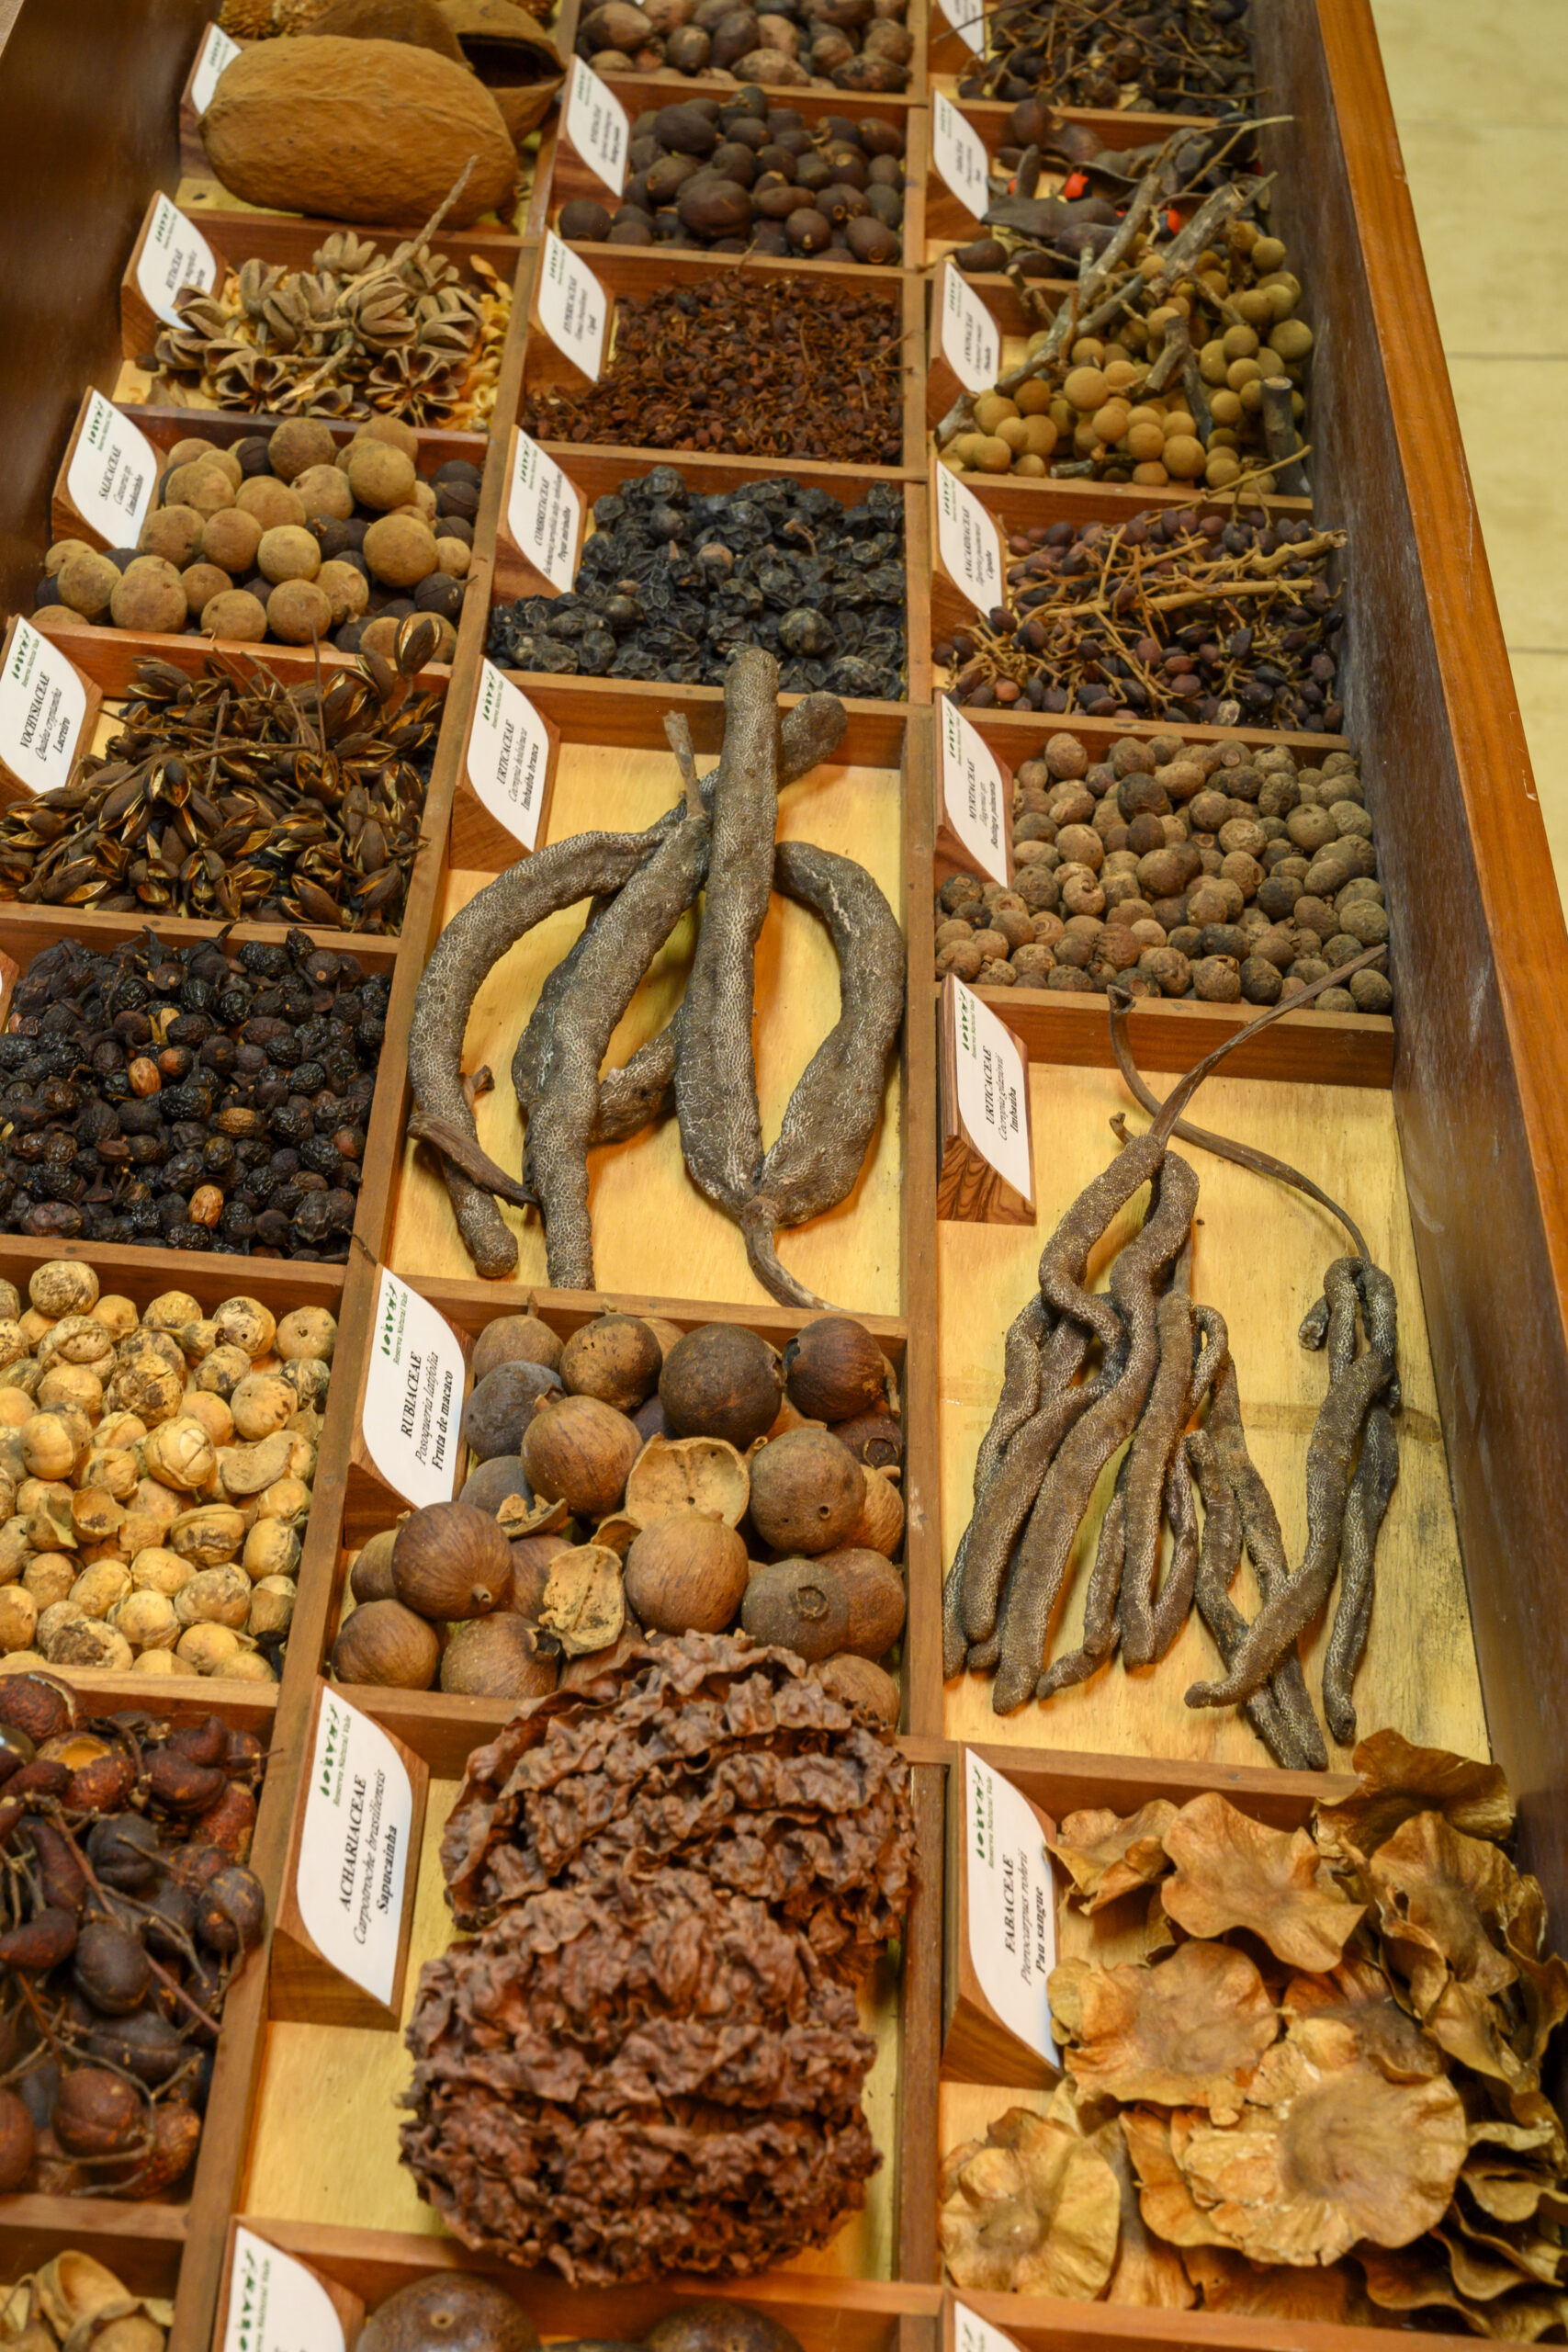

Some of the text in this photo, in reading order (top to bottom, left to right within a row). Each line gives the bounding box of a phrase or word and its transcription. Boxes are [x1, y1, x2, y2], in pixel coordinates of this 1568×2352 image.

[98, 445, 122, 501] SALICACEAE
[534, 476, 549, 547] COMBRETACEAE
[19, 672, 50, 749] VOCHYSIACEAE
[35, 731, 51, 762] Qualea
[52, 717, 71, 753] Lacreiro
[496, 718, 514, 785] URTICACEAE
[508, 766, 522, 802] Cecropia
[528, 742, 539, 772] branca
[966, 758, 977, 822] MYRTACEAE
[982, 1046, 995, 1125] URTICACEAE
[998, 1098, 1009, 1141] Cecropia
[392, 1292, 409, 1366] Reserva Natural Vale
[400, 1351, 422, 1439] RUBIACEAE
[415, 1351, 439, 1466] Posoqueria latifolia
[432, 1370, 453, 1471] Fruta de macaco
[333, 1714, 352, 1808] Reserva Natural Vale
[339, 1774, 367, 1913] ACHARIACEAE
[353, 1769, 386, 1946] Carpotroche brasiliensis
[376, 1824, 398, 1915] Sapucainha
[1001, 1854, 1015, 1955] FABACEAE
[1017, 1848, 1032, 1986] Pterocarpus rohrii
[1033, 1886, 1046, 1973] Pau sangue
